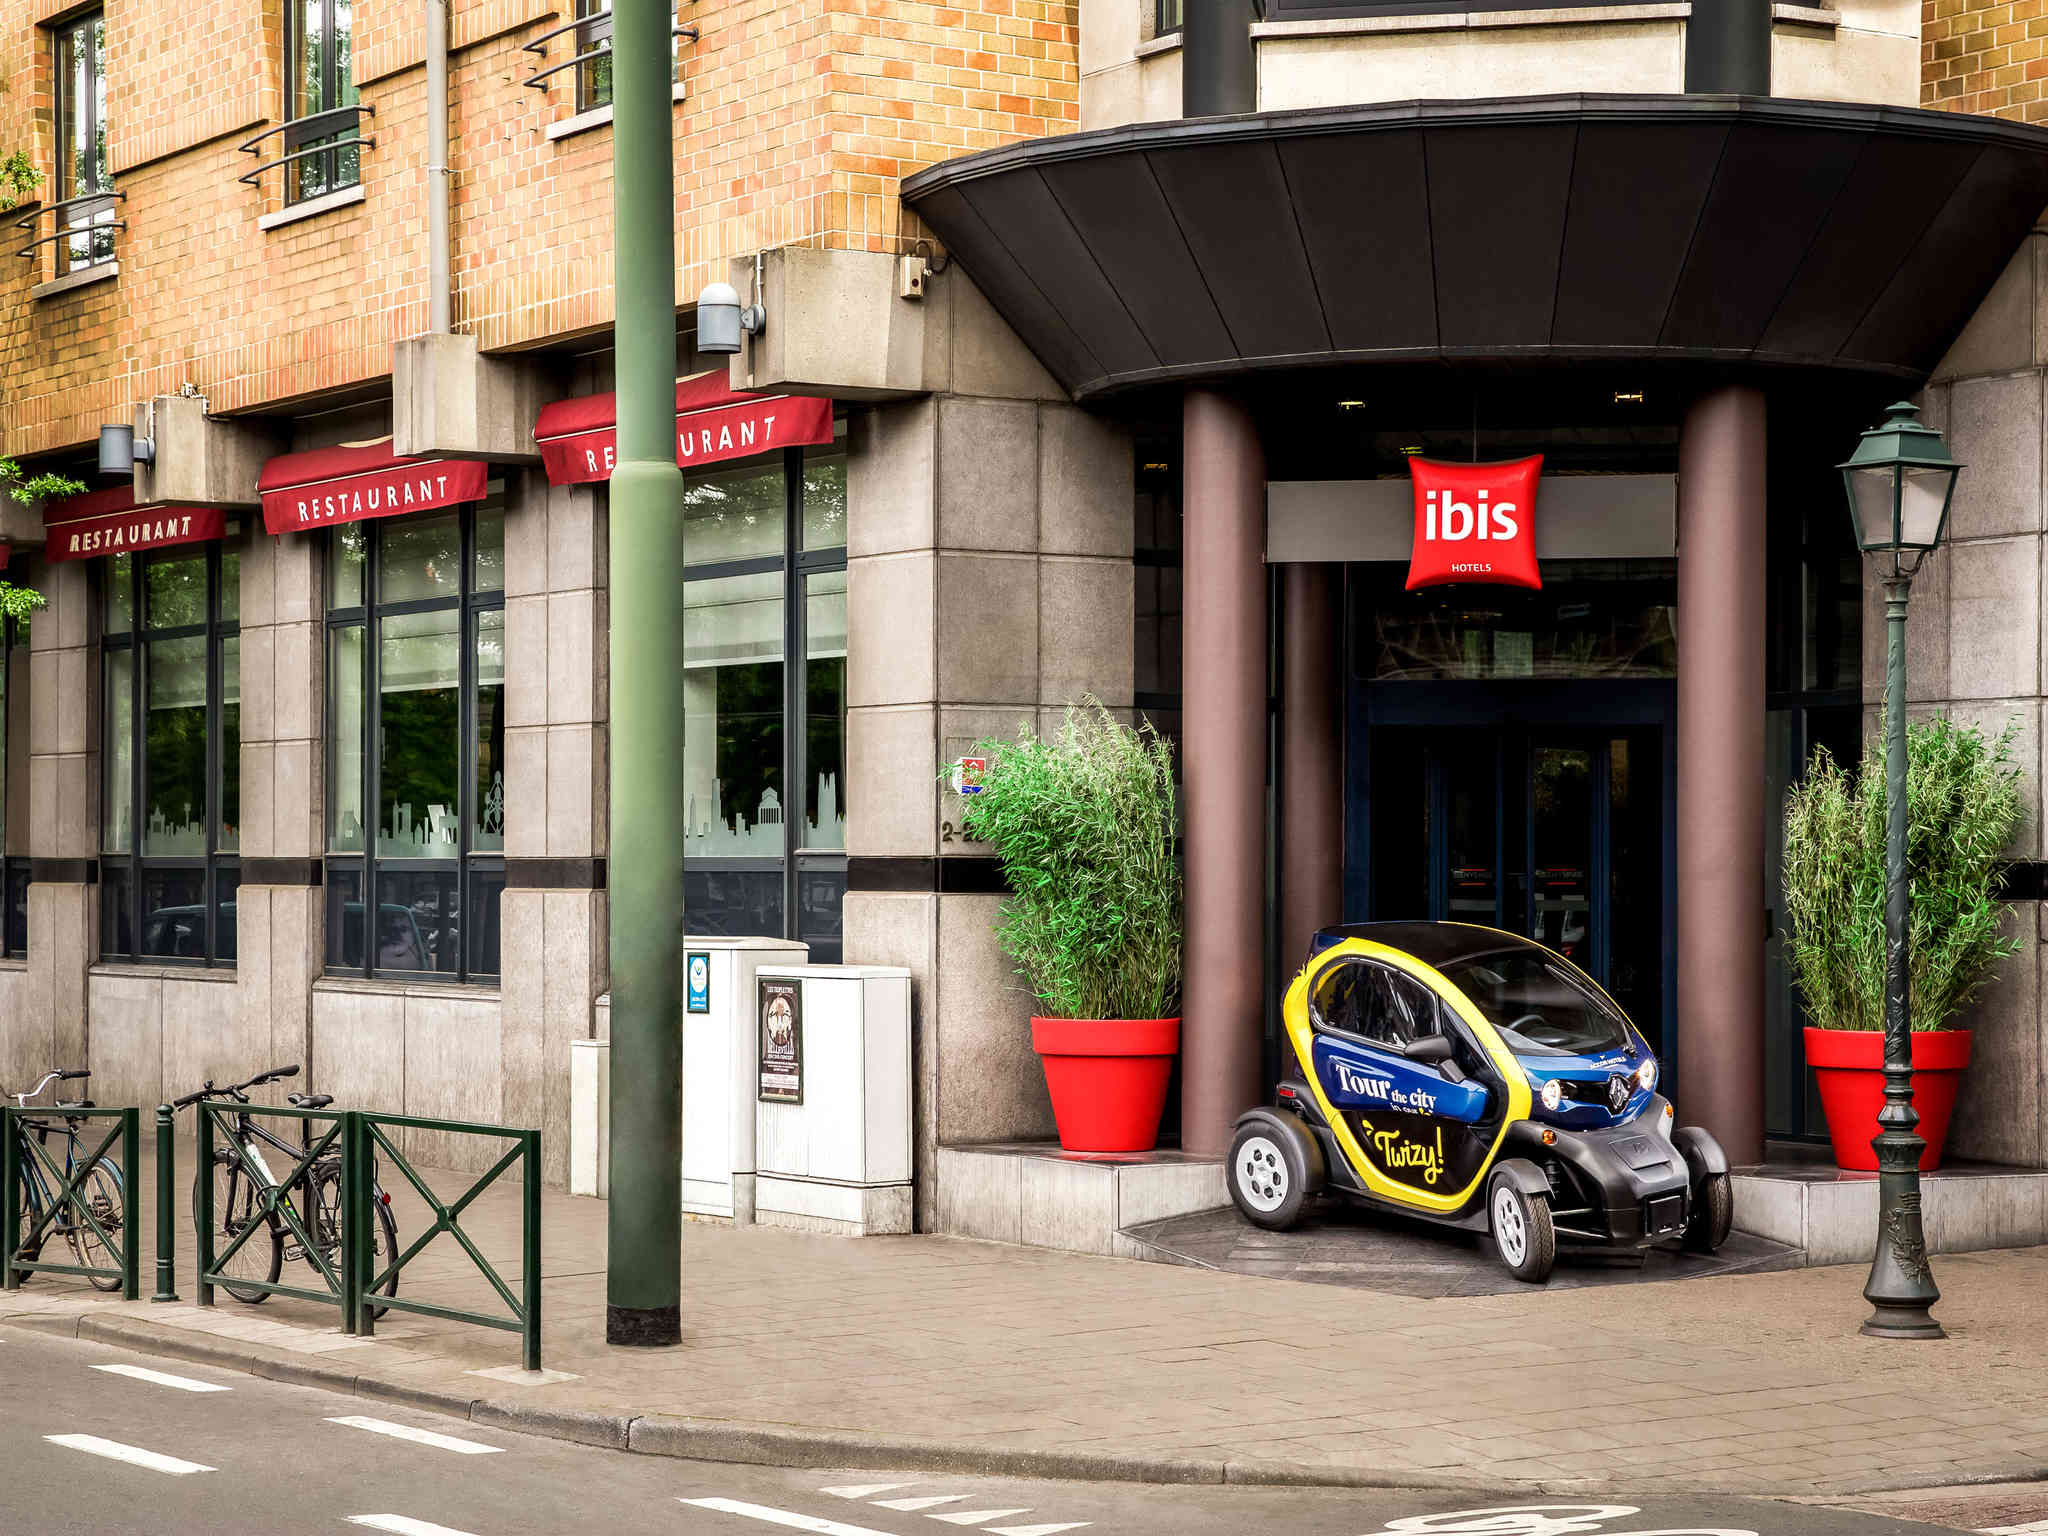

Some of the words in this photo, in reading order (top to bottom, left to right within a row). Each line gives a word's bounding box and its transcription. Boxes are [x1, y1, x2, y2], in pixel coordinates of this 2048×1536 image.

[585, 415, 776, 473] REURANT
[297, 475, 449, 523] RESTAURANT
[1425, 489, 1519, 541] ibis
[68, 515, 193, 553] RESTAURANT
[1451, 563, 1492, 573] HOTELS
[1335, 1064, 1391, 1100] Tour
[1391, 1089, 1408, 1104] the
[1409, 1088, 1437, 1112] city
[1374, 1126, 1444, 1185] Twizy!
